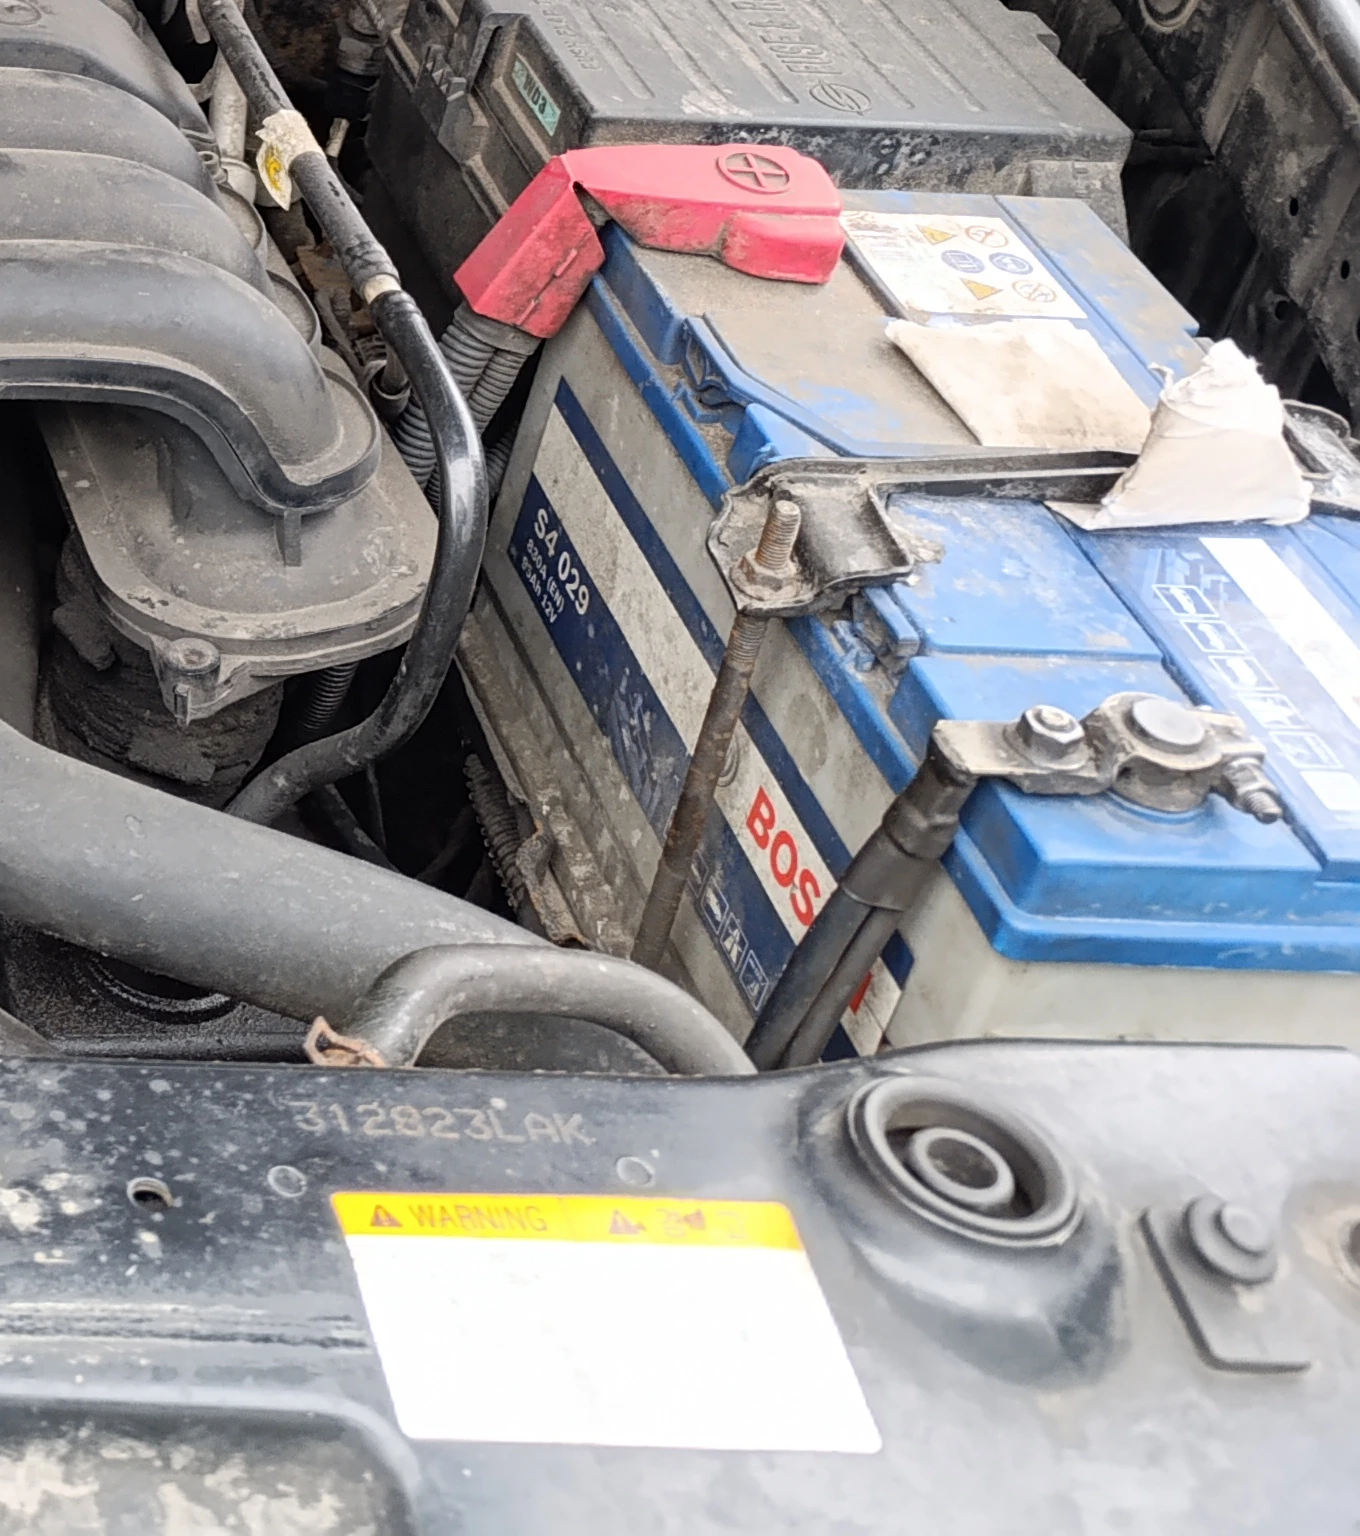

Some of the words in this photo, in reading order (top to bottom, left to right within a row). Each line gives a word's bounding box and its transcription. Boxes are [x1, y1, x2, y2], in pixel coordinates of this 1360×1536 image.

[759, 34, 843, 75] FUSE
[534, 508, 559, 558] S4
[557, 551, 590, 615] 029
[541, 594, 558, 624] 12V
[546, 576, 565, 613] (EN)
[407, 1203, 548, 1233] WARNING
